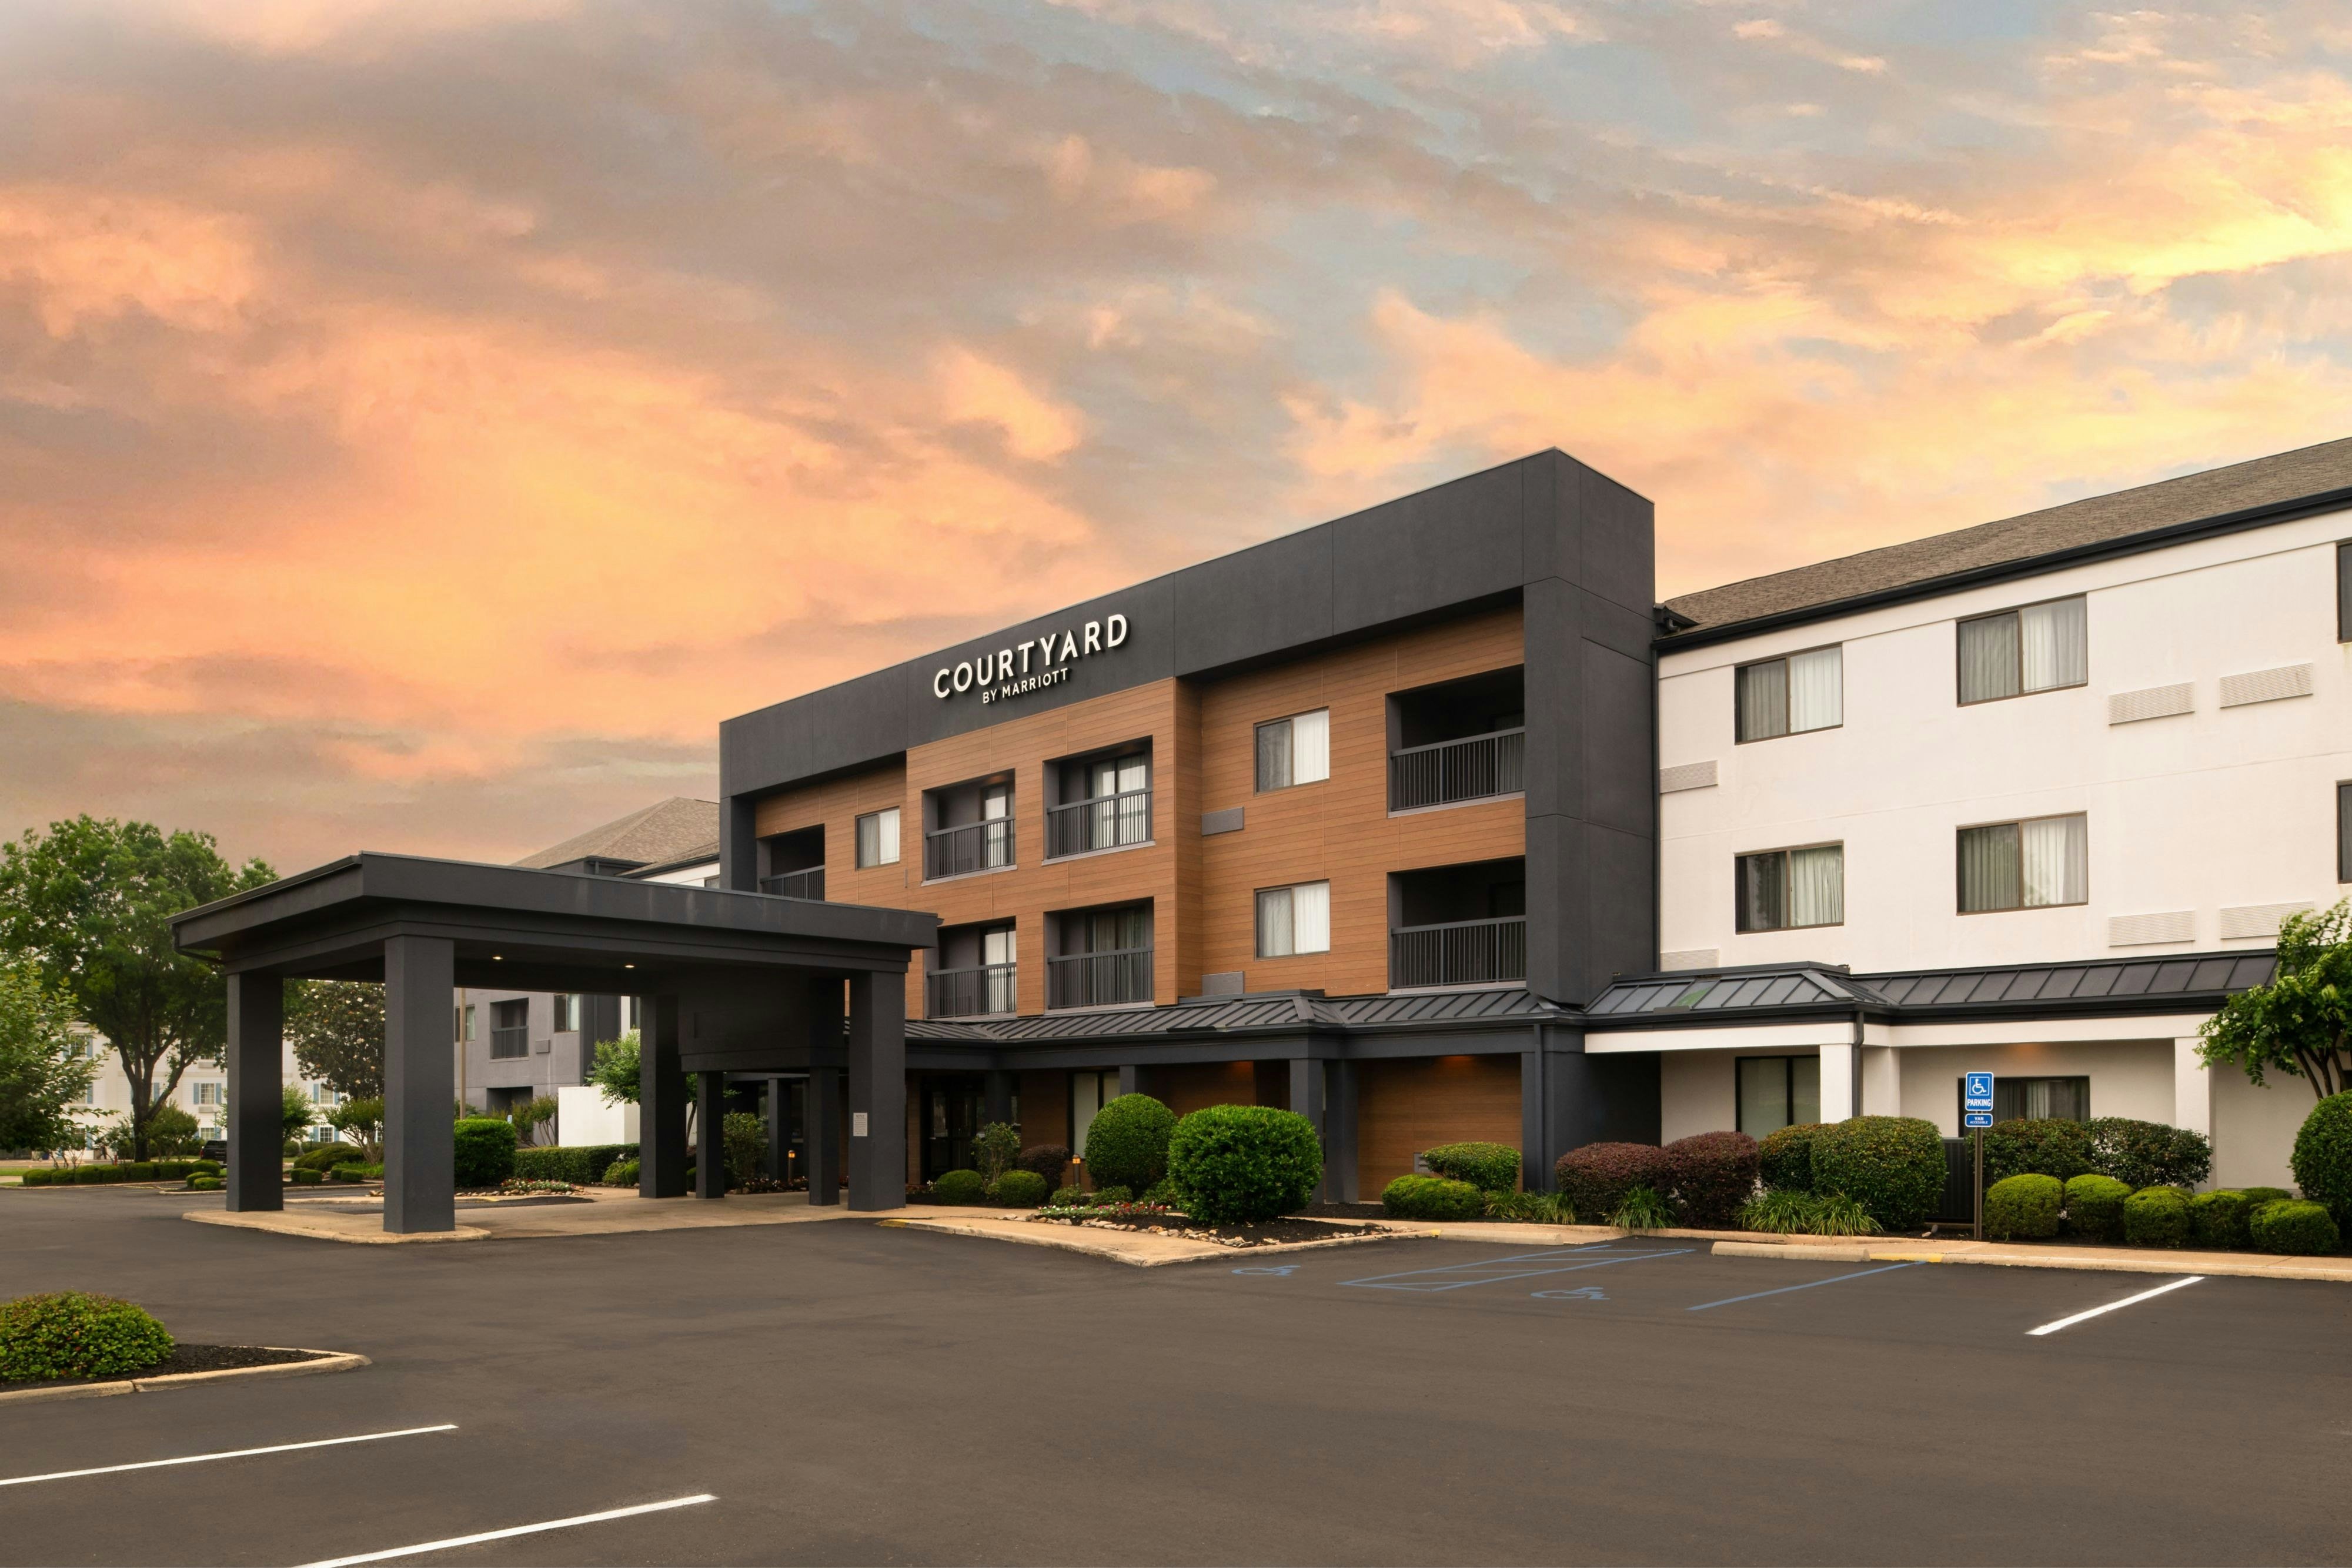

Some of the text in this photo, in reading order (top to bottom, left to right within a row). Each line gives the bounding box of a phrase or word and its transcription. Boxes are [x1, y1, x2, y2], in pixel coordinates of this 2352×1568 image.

[934, 614, 1128, 698] COURTYARD
[983, 667, 1068, 704] BY MARRIOTT
